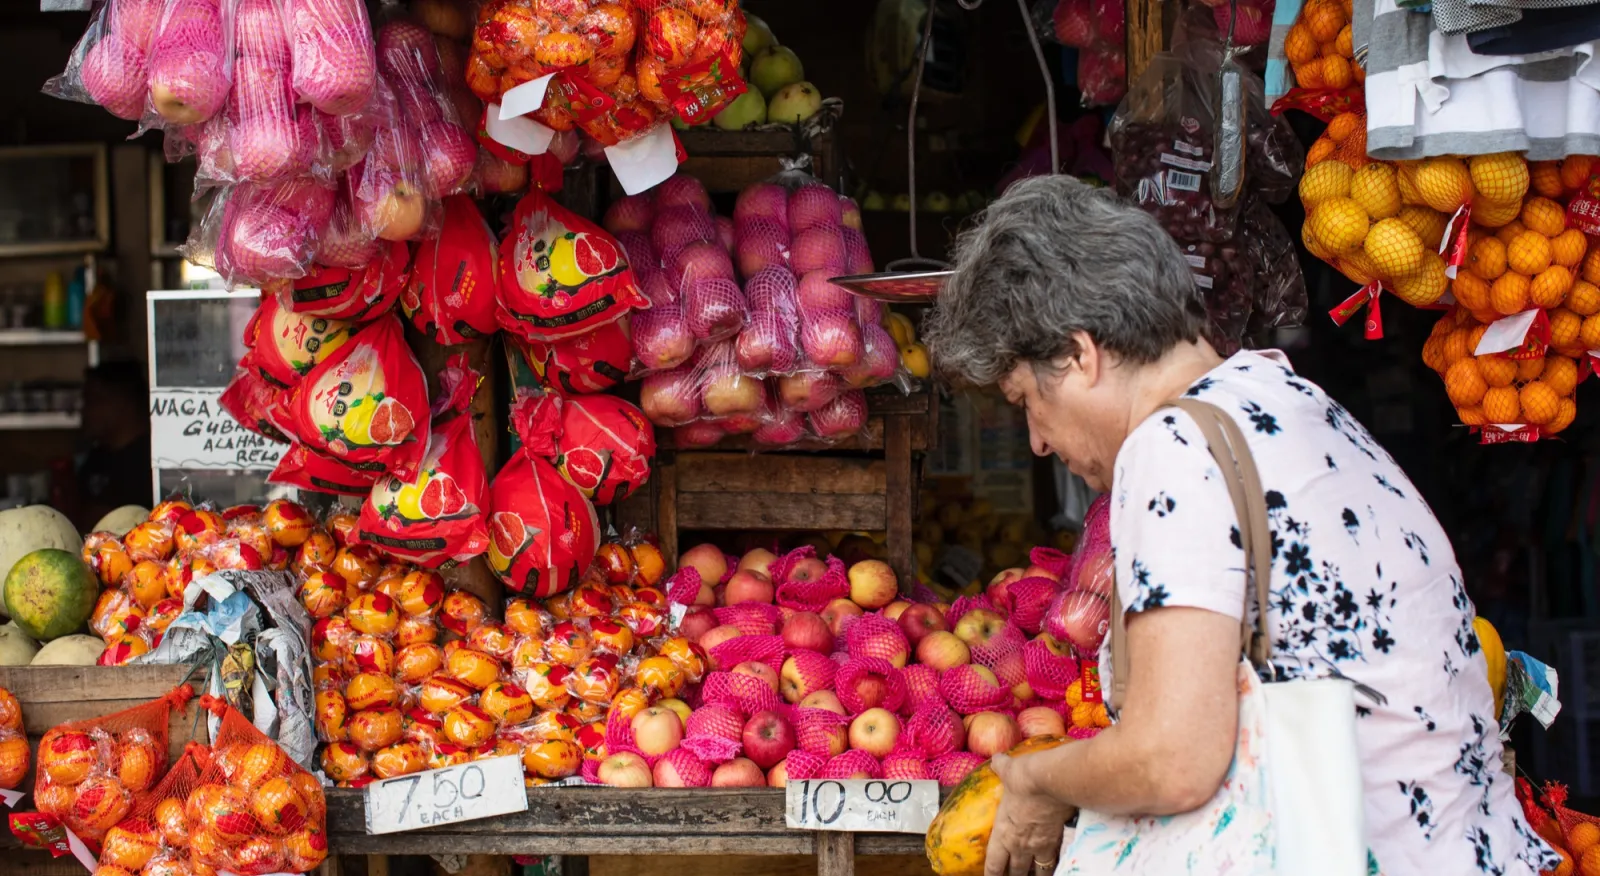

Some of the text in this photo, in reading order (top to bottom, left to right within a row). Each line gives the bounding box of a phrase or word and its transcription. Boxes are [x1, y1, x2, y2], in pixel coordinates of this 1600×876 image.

[151, 398, 210, 418] NAGA
[236, 449, 280, 462] RELO
[382, 765, 486, 824] 7.50
[800, 780, 912, 824] 10.00
[420, 806, 463, 824] EACH
[867, 810, 896, 822] EACH
